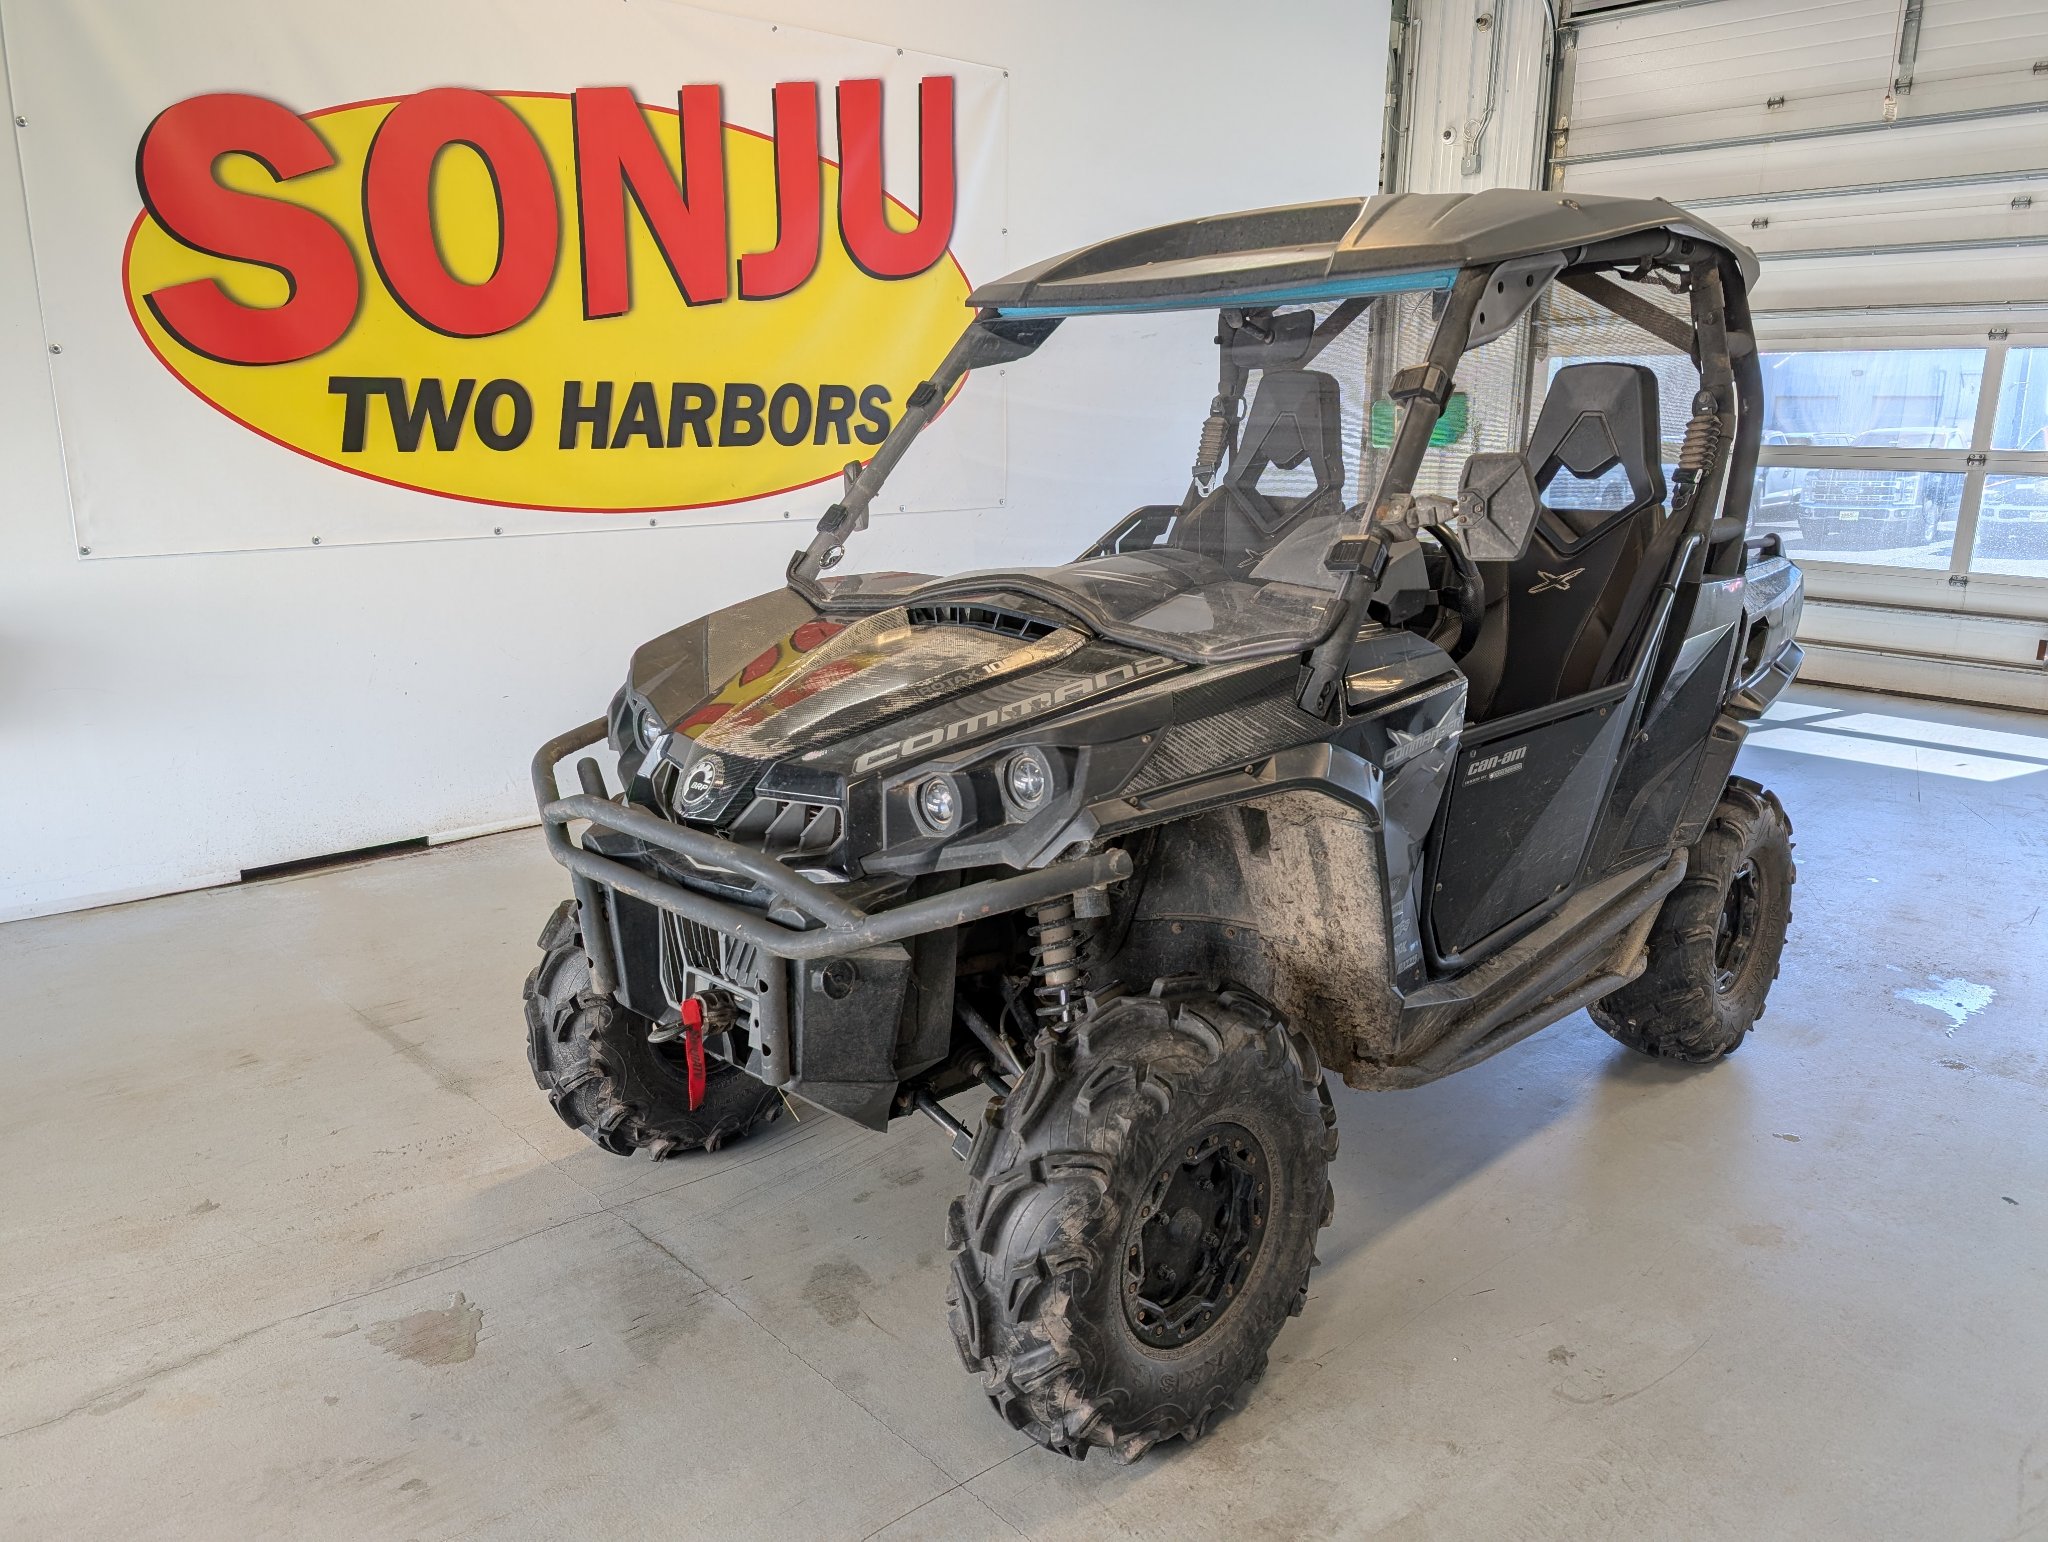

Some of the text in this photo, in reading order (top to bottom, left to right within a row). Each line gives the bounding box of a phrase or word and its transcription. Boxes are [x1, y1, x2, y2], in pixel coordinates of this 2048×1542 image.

[135, 76, 955, 366] SONJU
[328, 376, 893, 453] TWO HARBORS
[690, 781, 709, 791] BRP
[1467, 745, 1527, 776] can-am
